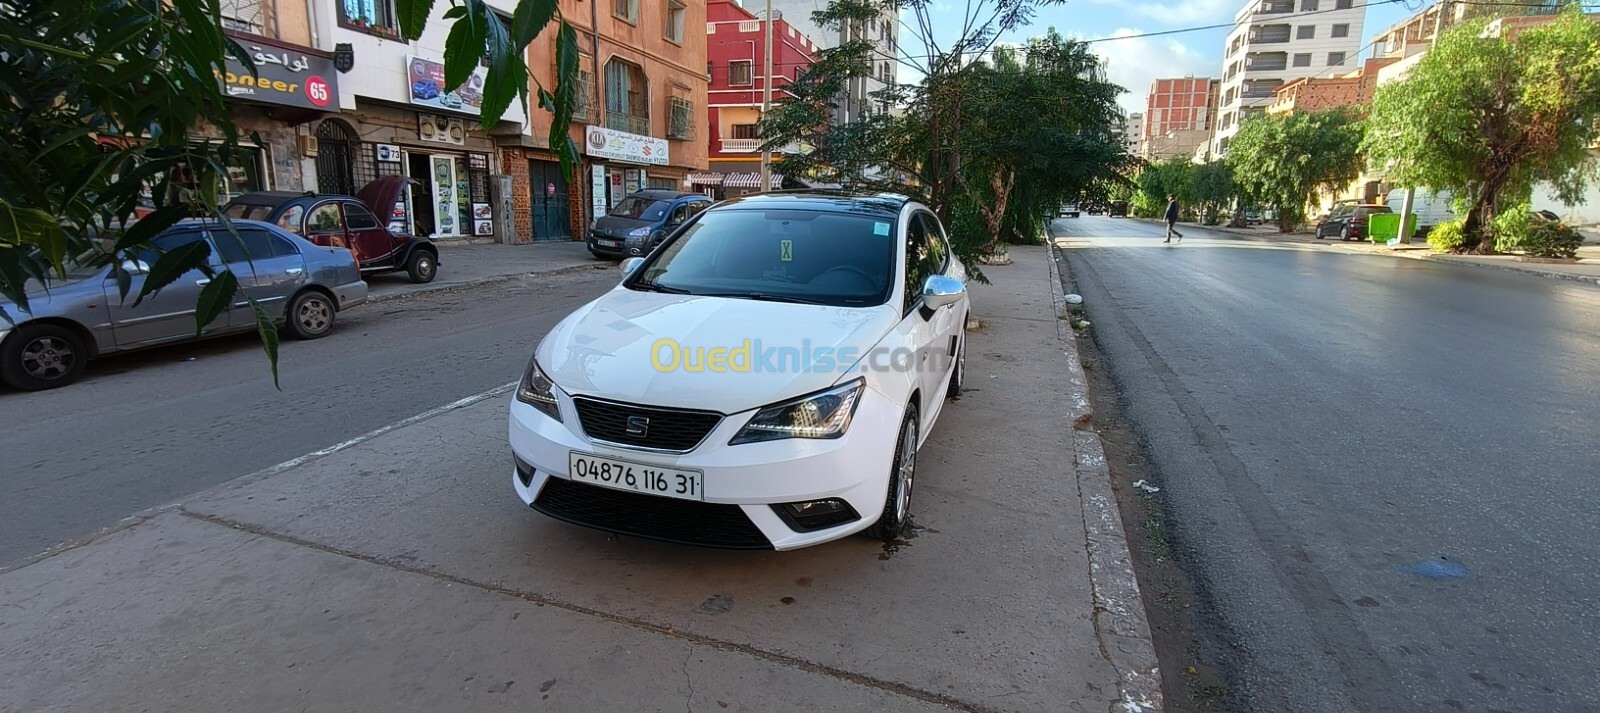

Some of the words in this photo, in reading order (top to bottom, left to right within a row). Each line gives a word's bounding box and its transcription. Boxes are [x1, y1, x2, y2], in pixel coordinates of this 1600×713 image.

[310, 82, 328, 101] 65
[391, 150, 399, 159] 73
[575, 458, 637, 486] 04876
[643, 469, 668, 491] 116
[675, 474, 695, 495] 31
